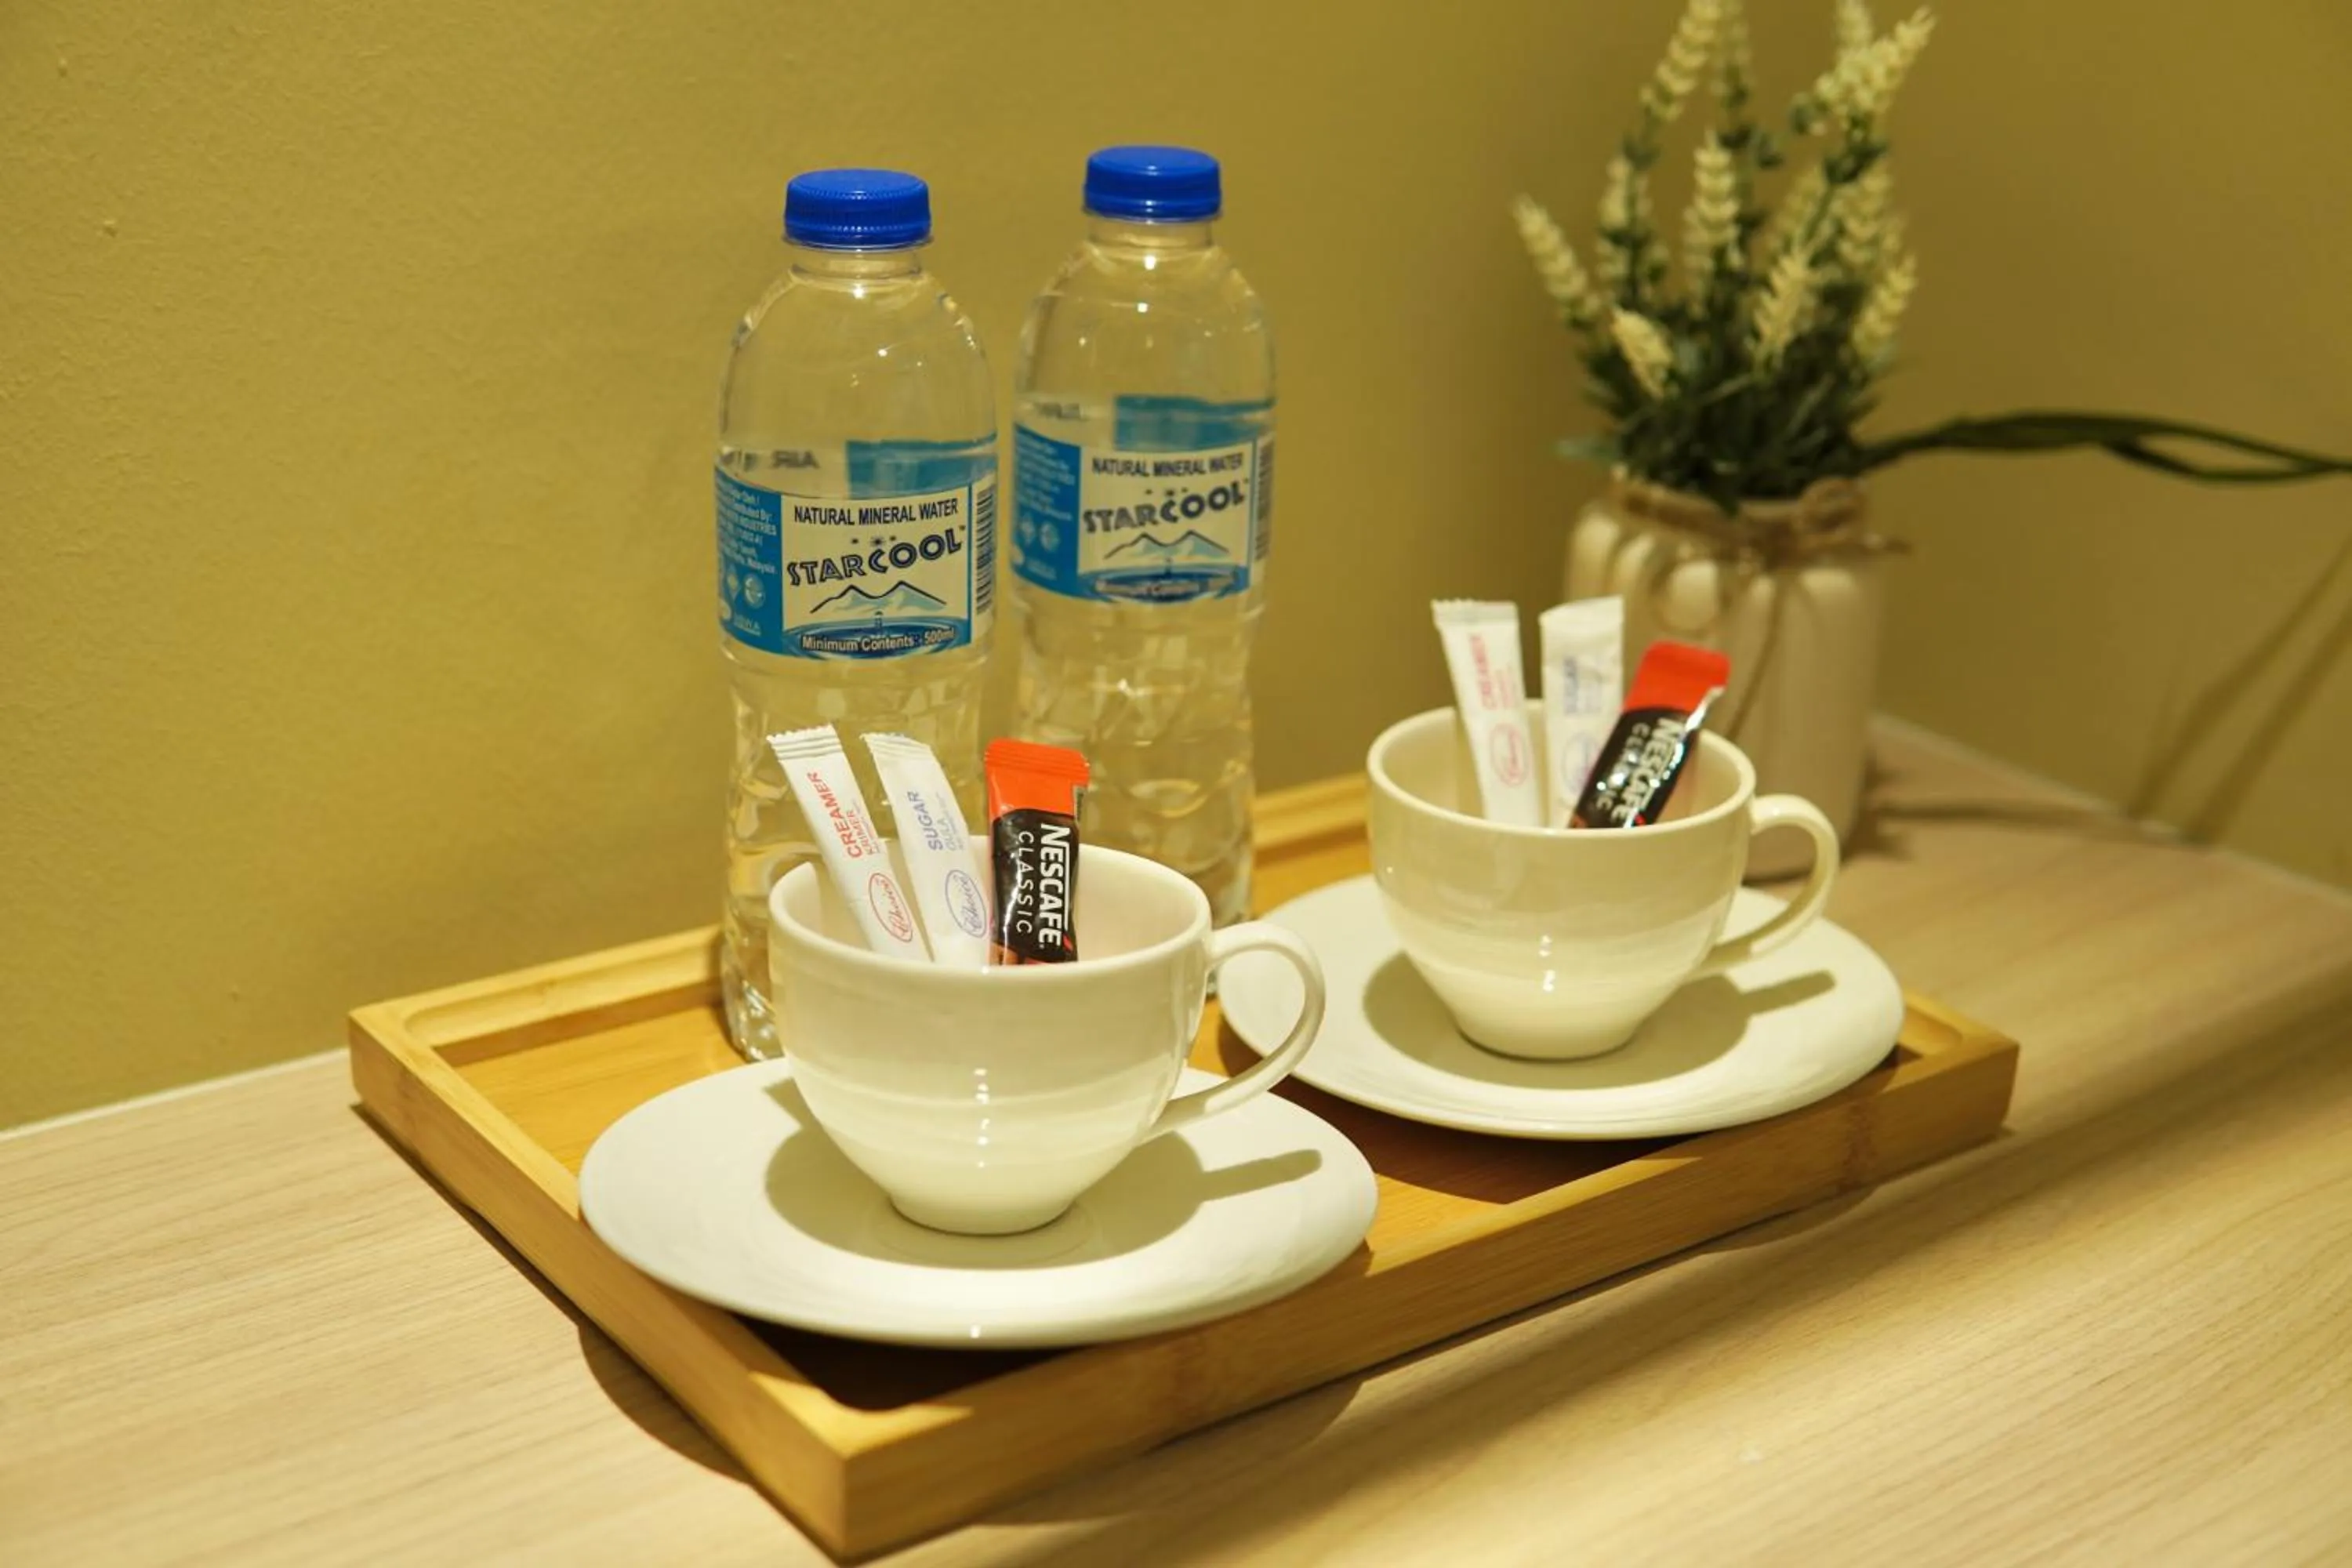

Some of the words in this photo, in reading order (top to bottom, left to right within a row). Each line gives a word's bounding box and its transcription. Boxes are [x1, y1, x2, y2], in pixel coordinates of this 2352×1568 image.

[793, 504, 855, 525] NATURAL
[858, 504, 916, 525] MINERAL
[918, 497, 959, 521] WATER
[1083, 480, 1246, 534] STARCOOL
[786, 527, 962, 587] STARCOOL
[801, 635, 858, 652] Minimum
[862, 635, 914, 652] Contents
[806, 771, 863, 858] CREAMER
[845, 810, 873, 856] KRIMER
[906, 790, 944, 851] SUGAR
[1015, 830, 1035, 935] CLASSIC
